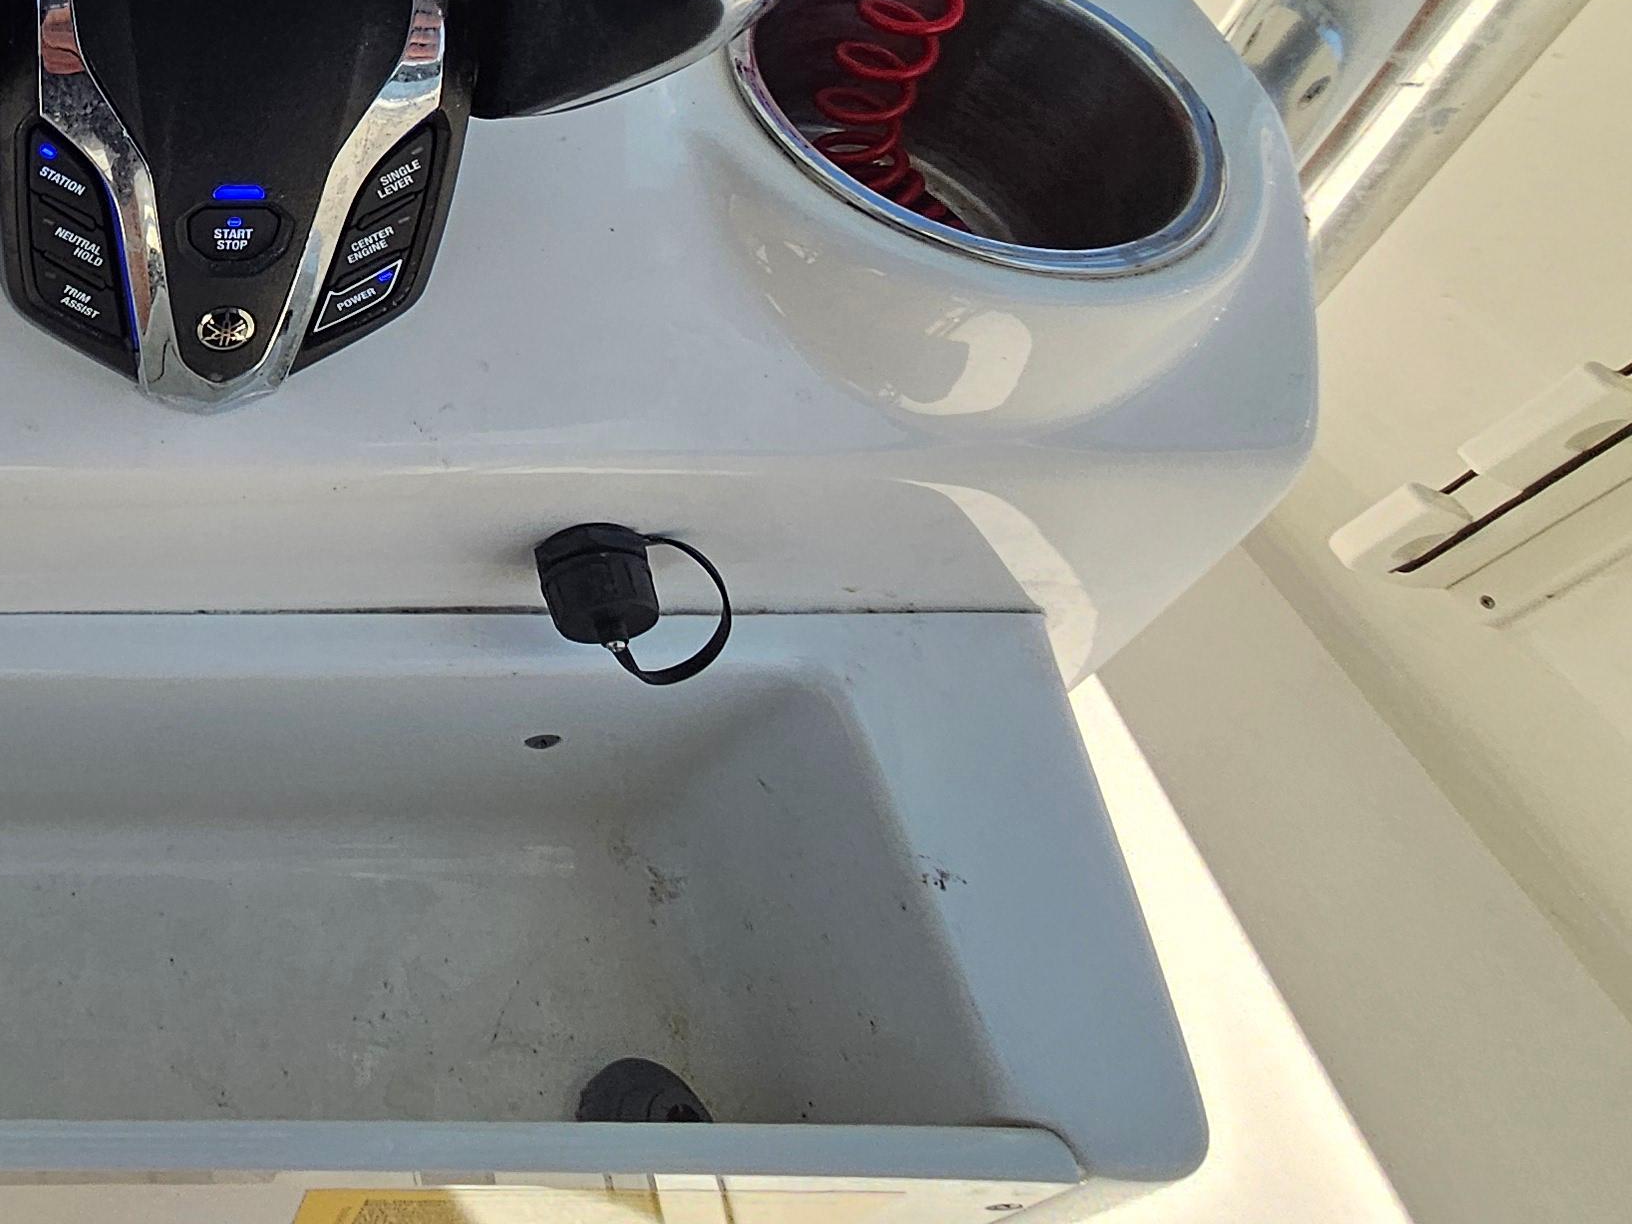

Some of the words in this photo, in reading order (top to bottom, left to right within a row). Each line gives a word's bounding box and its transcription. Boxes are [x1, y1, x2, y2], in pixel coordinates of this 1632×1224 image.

[39, 166, 86, 196] STATION
[380, 159, 421, 187] SINGLE
[377, 175, 414, 200] LEVER
[55, 226, 101, 255] NEUTRAL
[213, 228, 254, 240] START
[216, 240, 248, 251] STOP
[351, 226, 395, 252] CENTER
[73, 247, 103, 267] HOLD
[347, 239, 388, 264] ENGINE
[63, 284, 92, 304] TRIM
[336, 287, 377, 312] POWER
[60, 297, 100, 319] ASSIST
